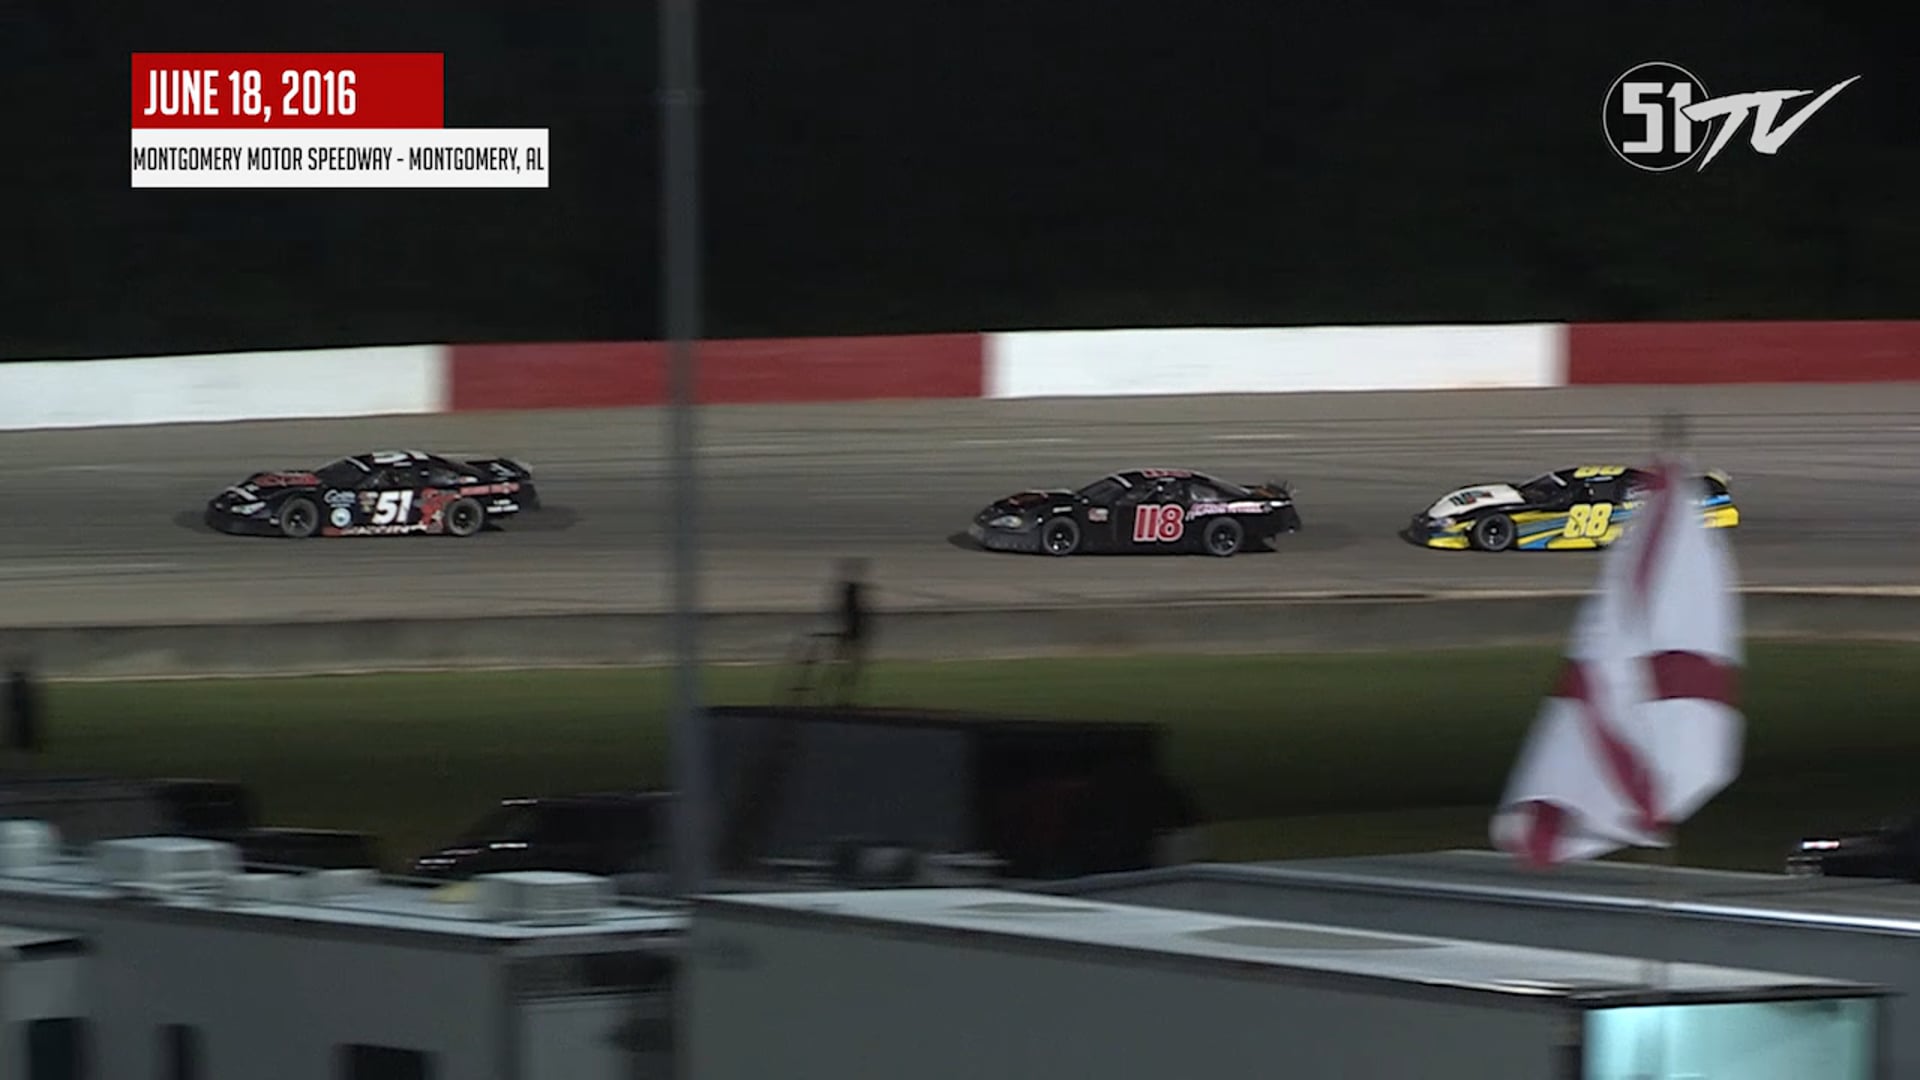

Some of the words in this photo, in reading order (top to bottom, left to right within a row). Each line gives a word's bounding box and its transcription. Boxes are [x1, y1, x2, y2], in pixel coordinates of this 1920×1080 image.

[371, 490, 414, 524] 51
[1133, 504, 1185, 541] 118
[1563, 503, 1613, 538] 88
